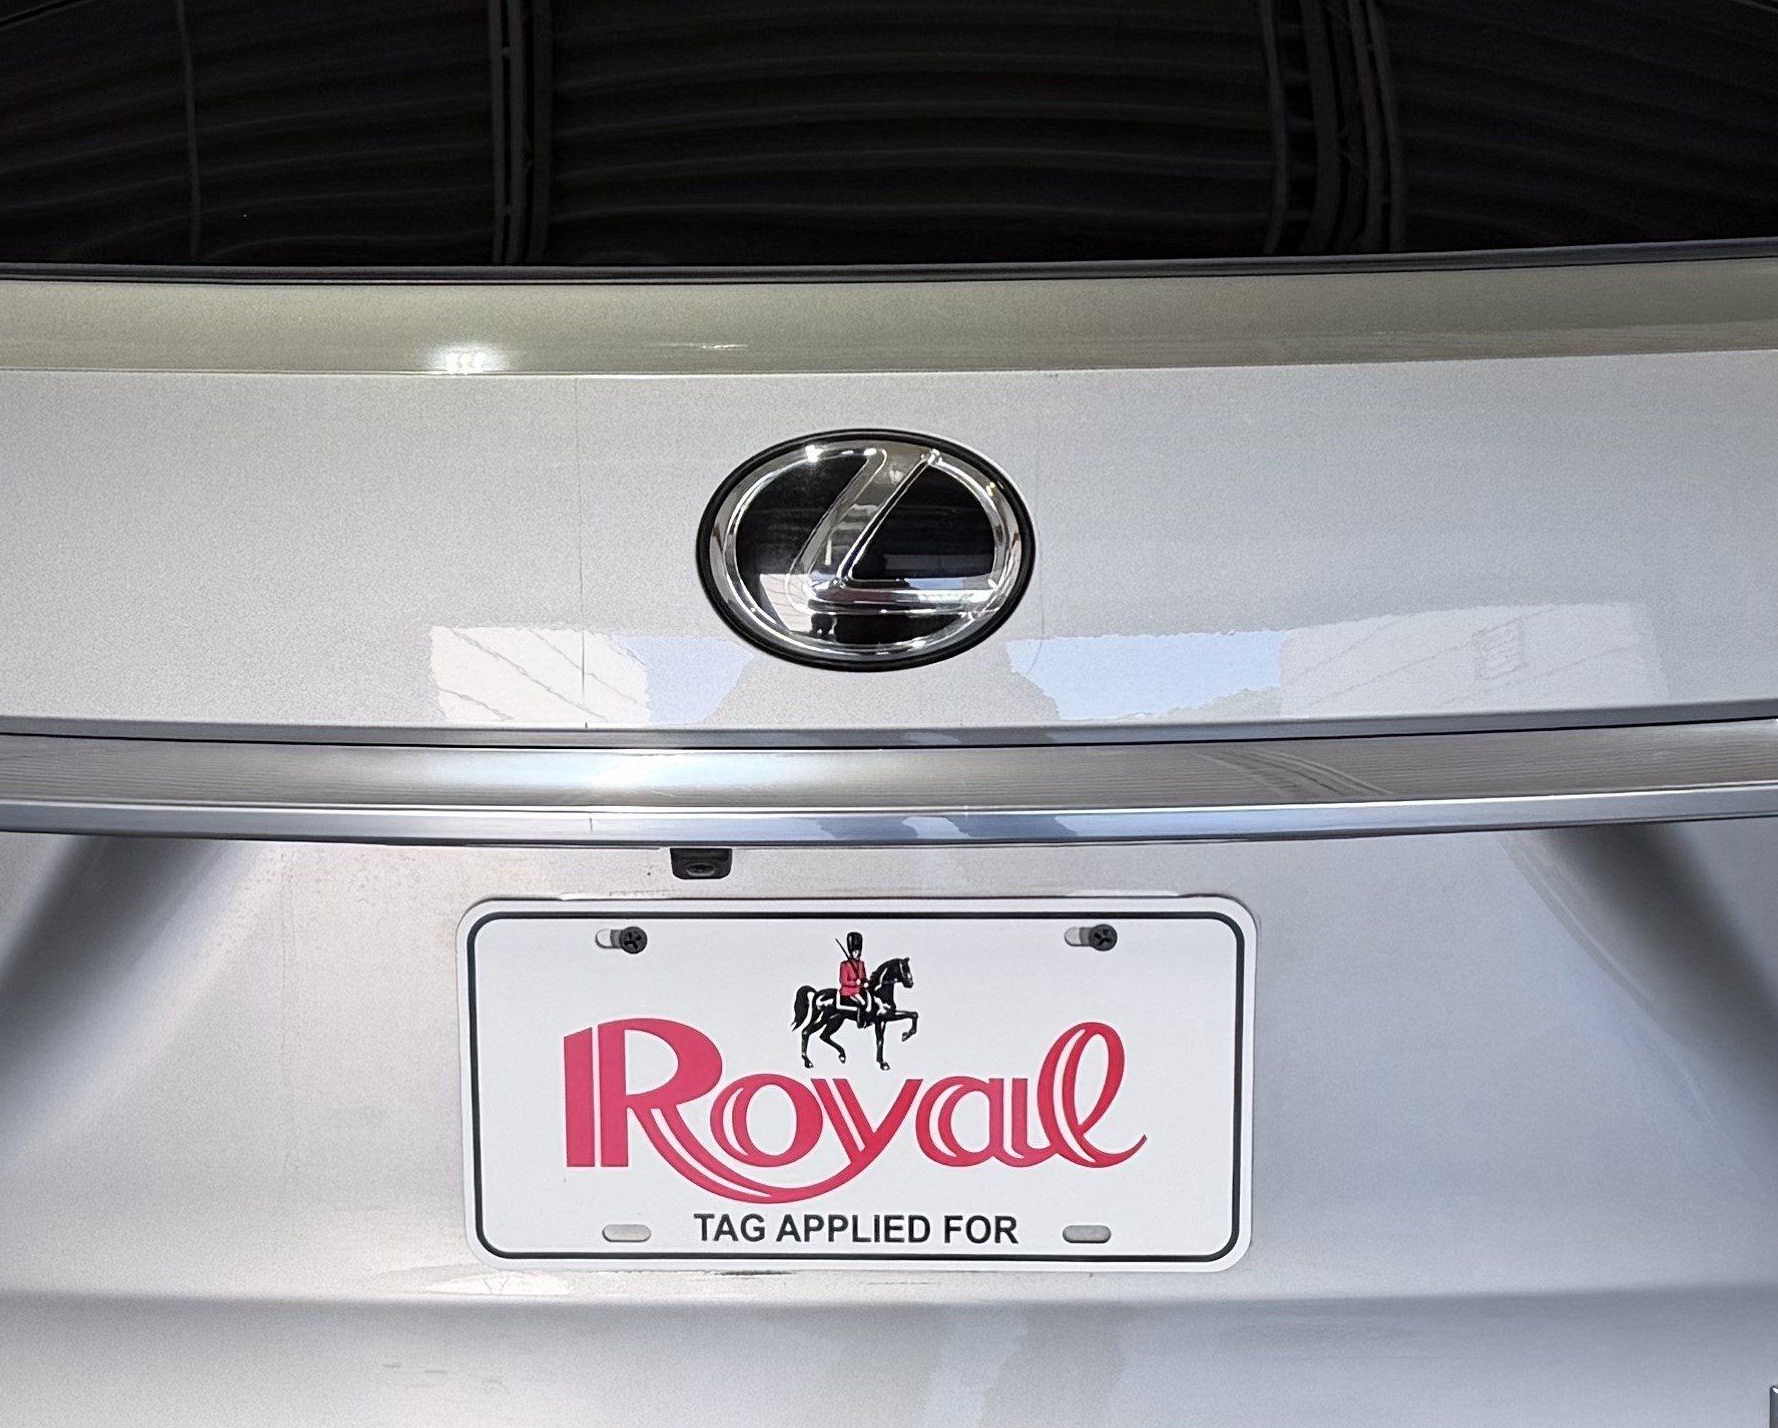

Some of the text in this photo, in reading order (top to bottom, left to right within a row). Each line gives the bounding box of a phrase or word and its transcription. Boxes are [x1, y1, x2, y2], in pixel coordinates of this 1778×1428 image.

[563, 1017, 1147, 1204] Royal
[693, 1213, 1019, 1245] TAG APPLIED FOR
